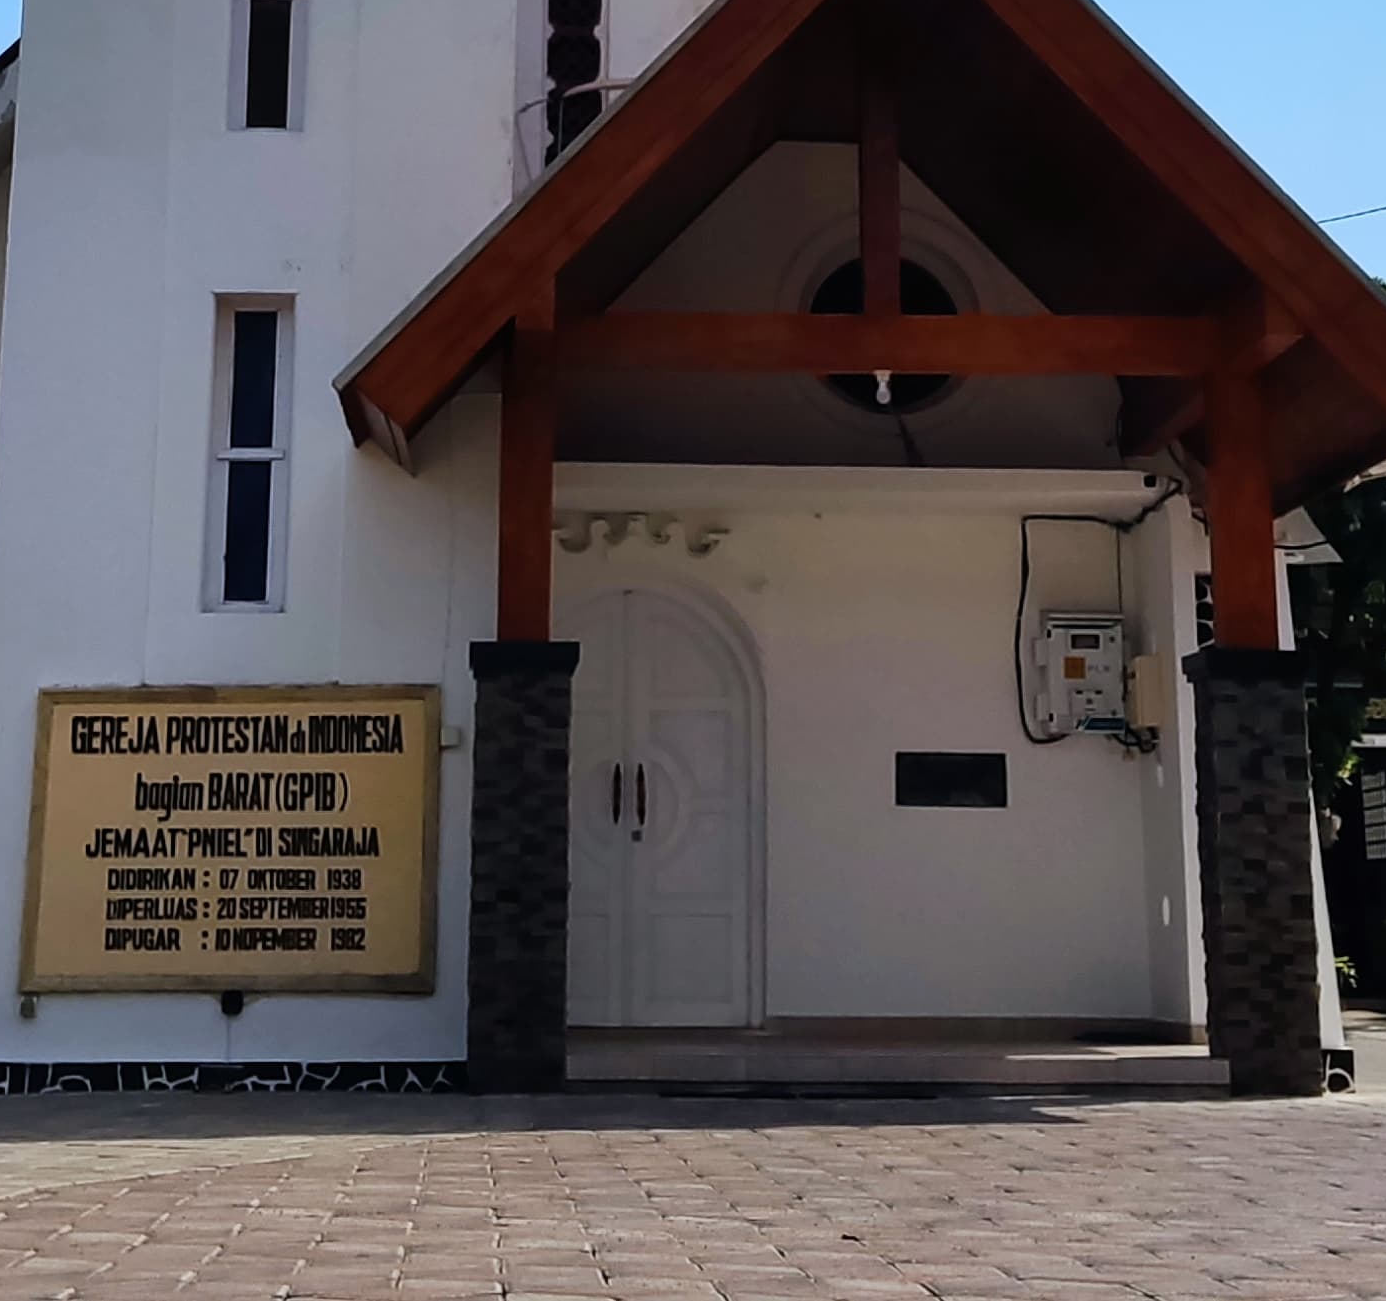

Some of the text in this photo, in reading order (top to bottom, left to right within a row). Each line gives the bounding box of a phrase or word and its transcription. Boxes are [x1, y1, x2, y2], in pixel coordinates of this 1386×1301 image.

[71, 713, 404, 755] GEREJA PROTESTAN di INDONESIA
[134, 772, 349, 823] bagian BARAT (GPIB)
[85, 827, 180, 859] JEMAAT
[255, 827, 273, 858] DI
[278, 826, 380, 858] SINGARAJA
[107, 867, 196, 891] DIDIRIKAN
[219, 868, 240, 891] 07
[247, 868, 316, 891] OKTOBER
[327, 868, 362, 891] 1938
[105, 897, 198, 922] DIPERLUAS
[216, 897, 237, 921] 20
[238, 896, 330, 921] SEPTEMBER
[104, 927, 182, 952] DIPUGAR
[214, 927, 232, 952] 10
[232, 927, 318, 952] NOPEMBER
[330, 927, 367, 952] 1982
